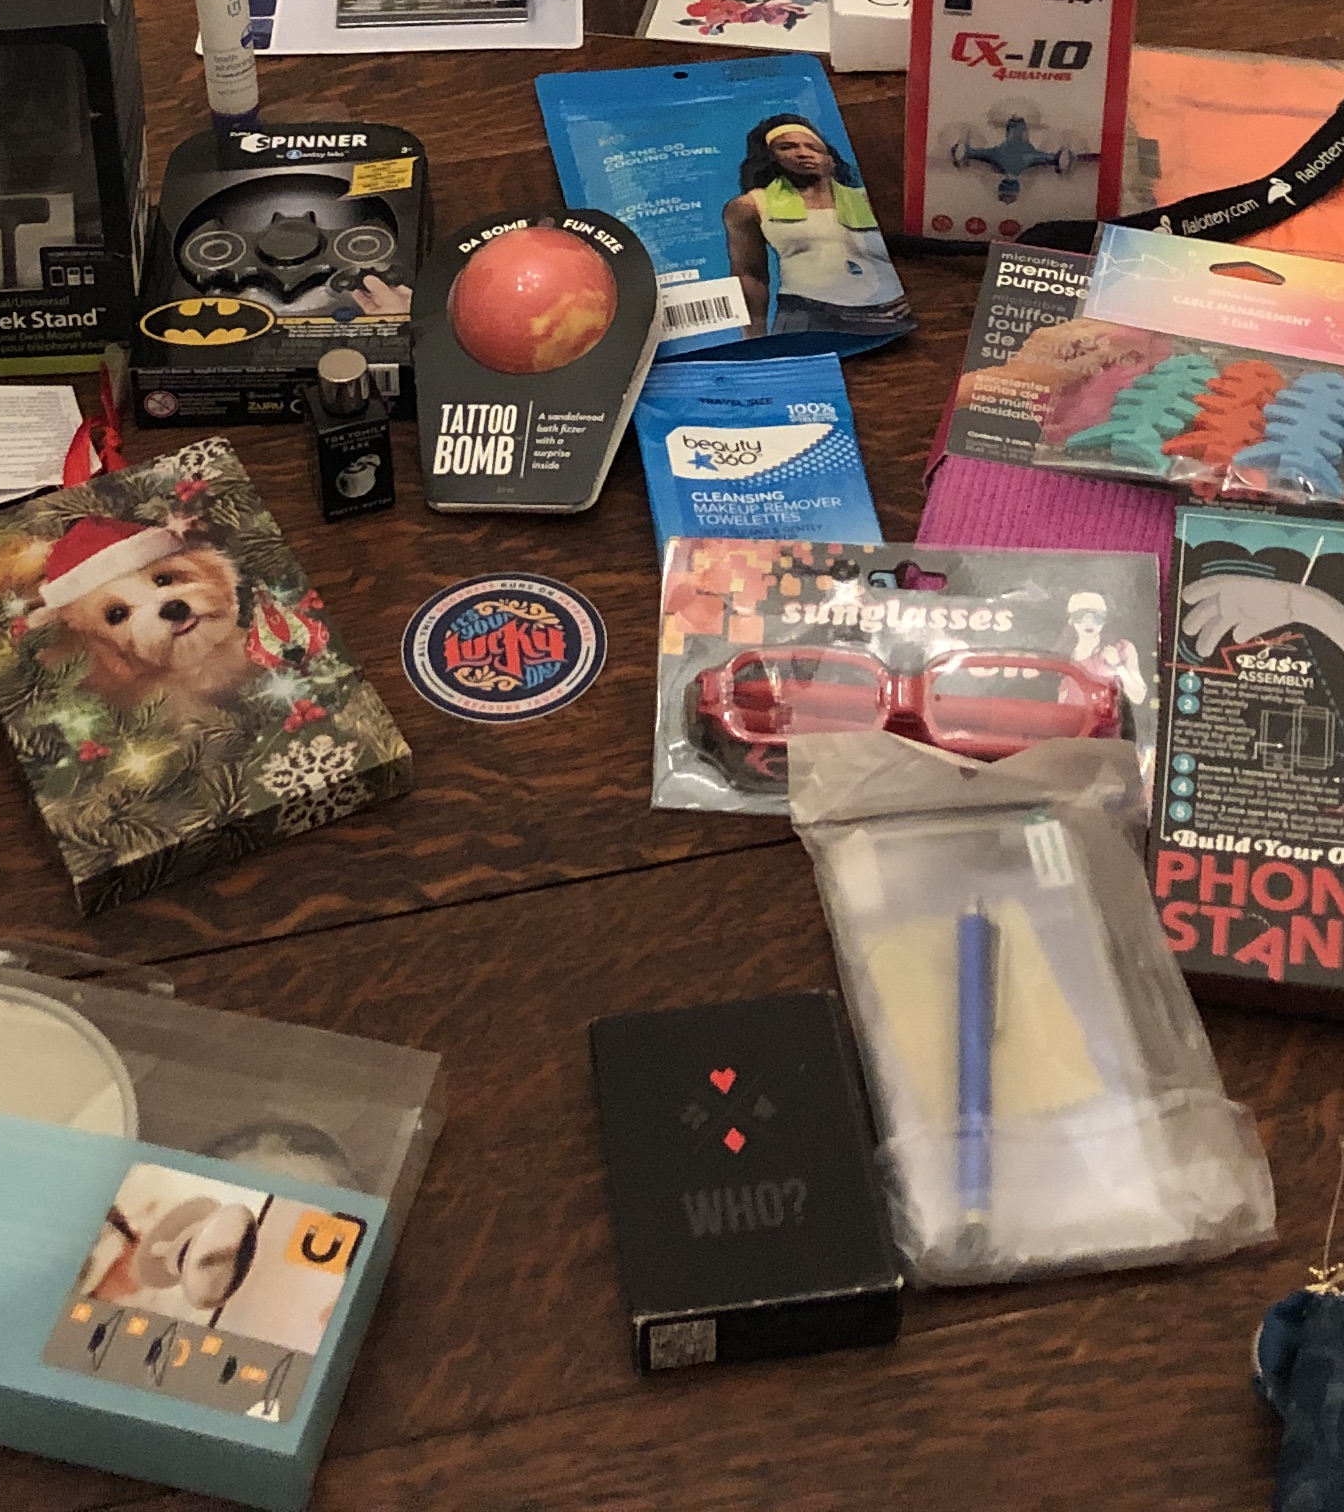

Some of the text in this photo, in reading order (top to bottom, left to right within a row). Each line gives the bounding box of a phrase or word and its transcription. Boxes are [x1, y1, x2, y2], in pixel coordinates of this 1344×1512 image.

[951, 32, 1093, 69] CX-10
[256, 134, 368, 149] SPINNER
[603, 143, 685, 165] ON-THE-GO
[605, 145, 721, 173] COOLING TOWEL
[615, 196, 682, 217] COOLING
[458, 219, 529, 254] DA BOMB
[562, 218, 596, 235] FUN
[593, 230, 624, 255] SIZE
[1001, 252, 1074, 270] microfiber
[996, 274, 1089, 300] purpose
[1172, 296, 1214, 309] CABLE
[1216, 302, 1312, 326] MANAGEMENT
[987, 315, 1032, 335] tout
[984, 332, 1016, 347] de
[971, 392, 996, 404] uso
[1020, 388, 1039, 400] de
[538, 412, 605, 422] A sandalwood
[786, 402, 835, 415] 100%
[440, 403, 518, 434] TATTOO
[535, 436, 555, 445] with
[683, 434, 762, 453] beauty
[432, 435, 515, 476] BOMB
[532, 450, 571, 458] surprise
[713, 452, 757, 466] 360
[531, 461, 560, 470] inside
[691, 491, 784, 503] CLEANSING
[693, 496, 842, 514] MAKEUP REMOVER
[696, 512, 801, 526] TOWELETTES
[781, 596, 1014, 634] sunglasses
[1237, 670, 1315, 689] ASSEMBLY!
[1172, 828, 1255, 856] Build
[1253, 837, 1324, 864] Your
[680, 1178, 808, 1237] WHO?
